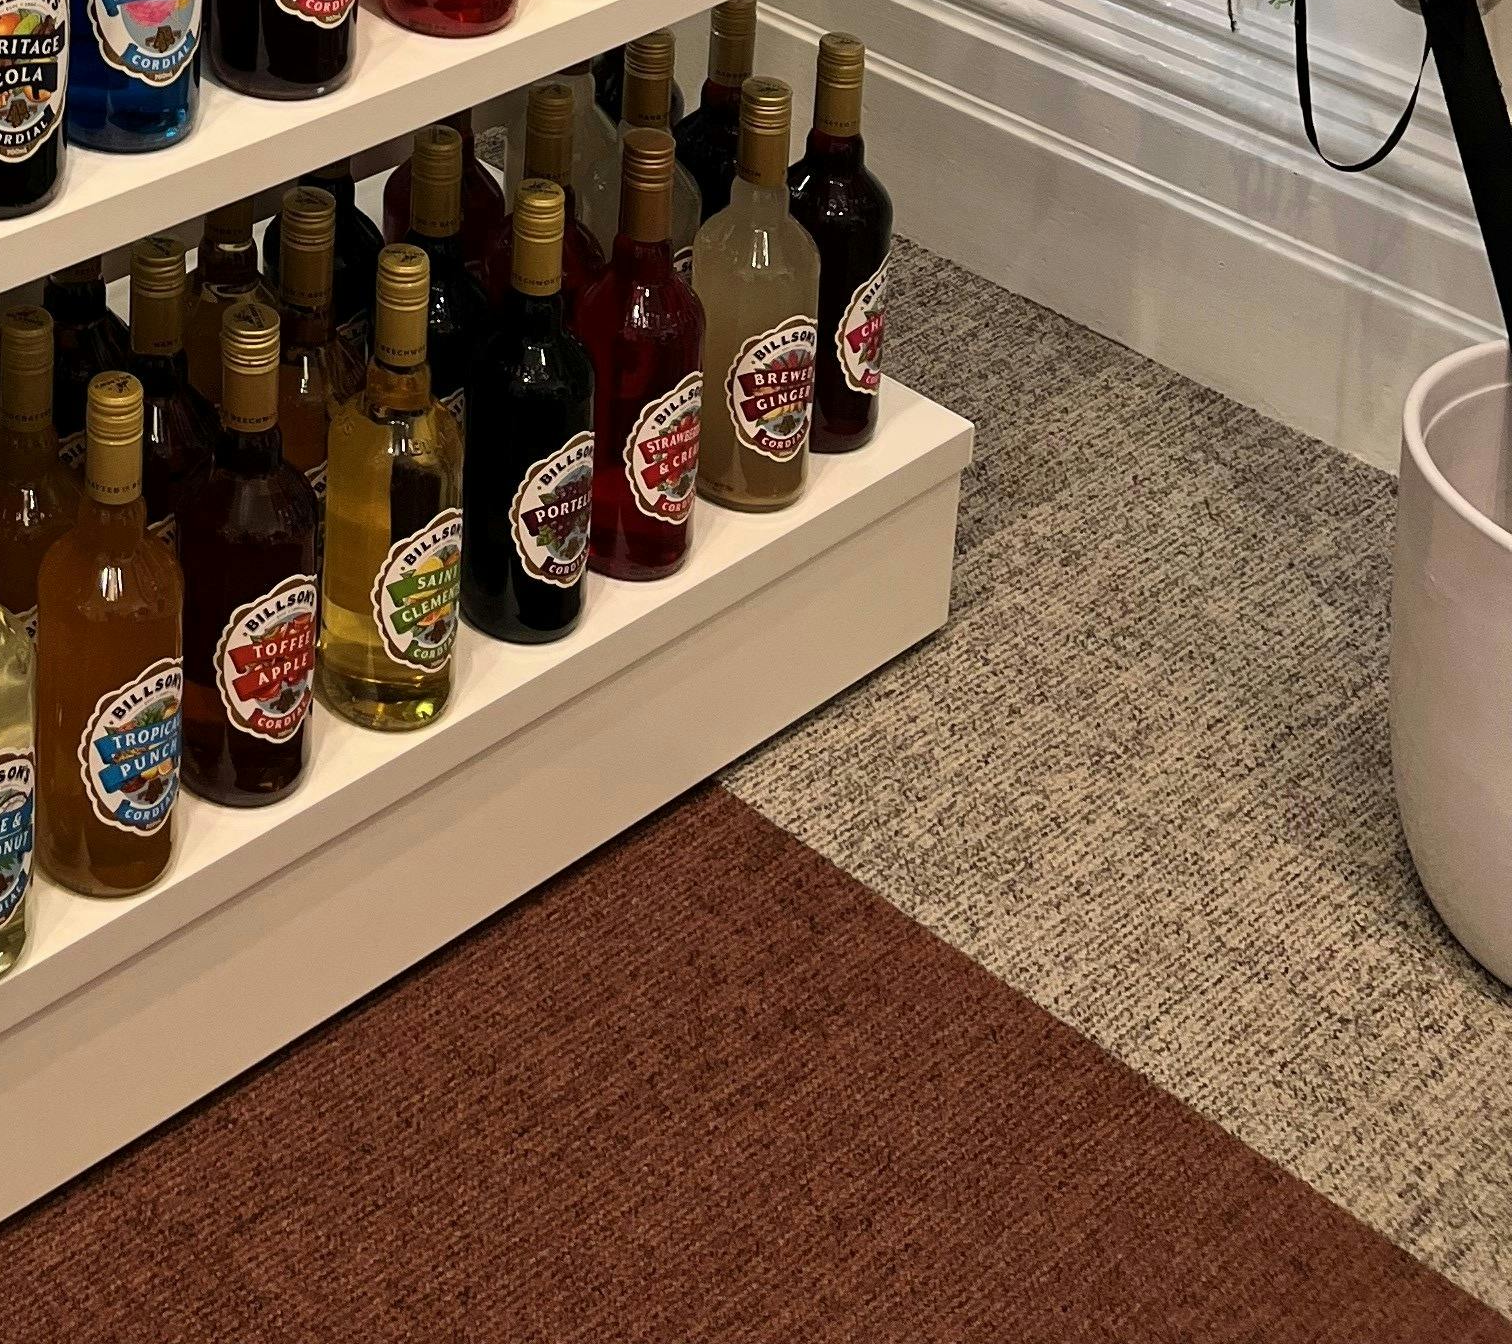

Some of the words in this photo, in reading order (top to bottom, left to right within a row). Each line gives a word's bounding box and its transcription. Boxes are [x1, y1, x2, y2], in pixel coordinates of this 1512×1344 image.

[131, 44, 193, 72] CORDIAL
[754, 366, 814, 386] BREWED
[659, 462, 669, 475] &
[535, 491, 591, 524] PORTEL
[253, 630, 311, 659] TOFFEE
[257, 652, 308, 686] APPLE
[112, 718, 180, 750] TROPICA
[119, 744, 178, 779] PUNCH
[10, 815, 22, 830] &
